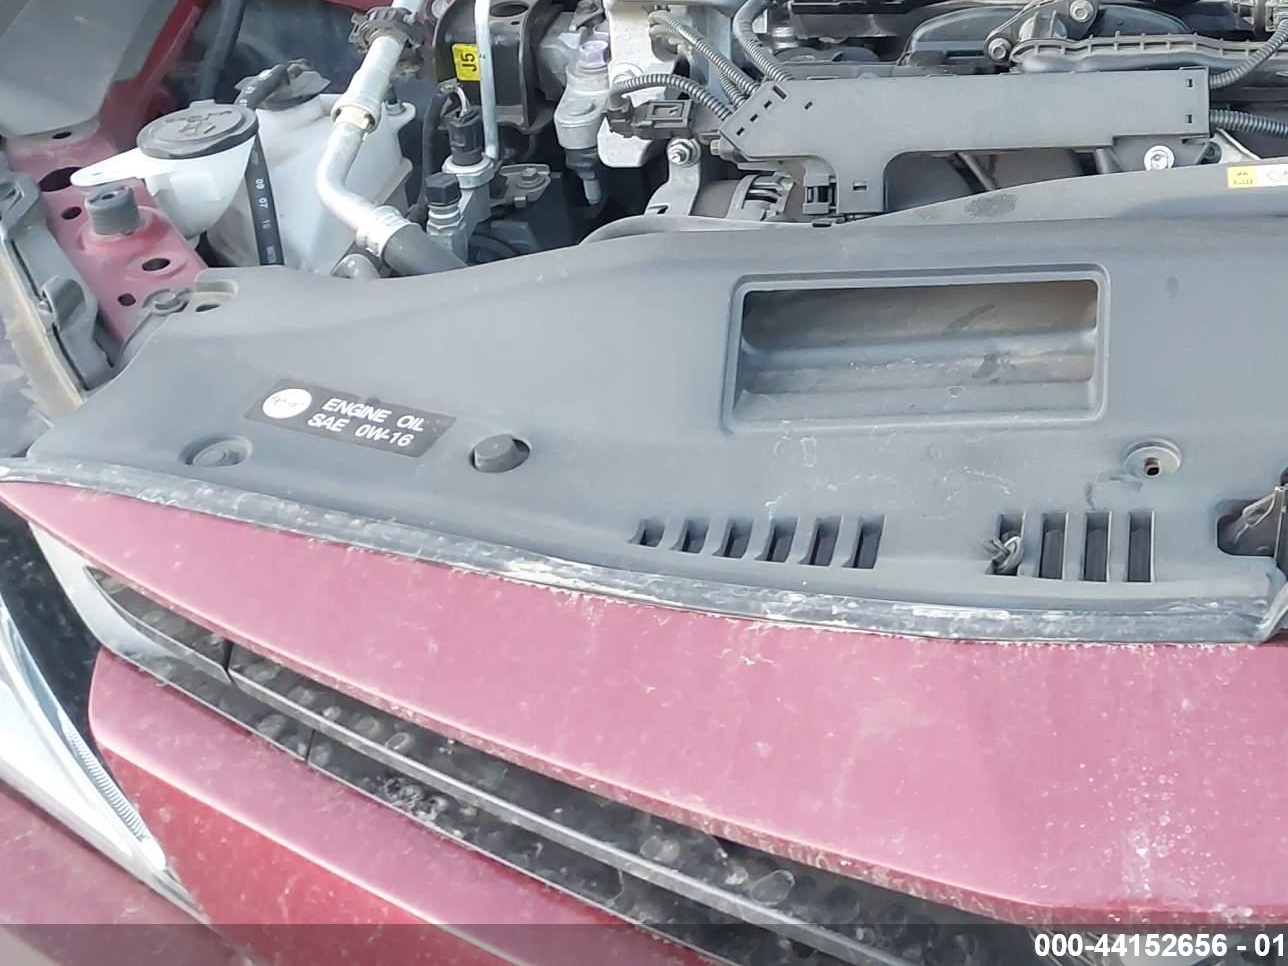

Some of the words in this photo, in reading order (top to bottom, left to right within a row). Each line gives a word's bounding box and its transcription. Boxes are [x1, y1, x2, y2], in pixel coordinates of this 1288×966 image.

[460, 52, 477, 72] J5
[307, 413, 350, 432] SAE
[355, 424, 415, 447] 0W-16
[322, 397, 392, 423] ENGINE
[396, 415, 425, 432] OIL
